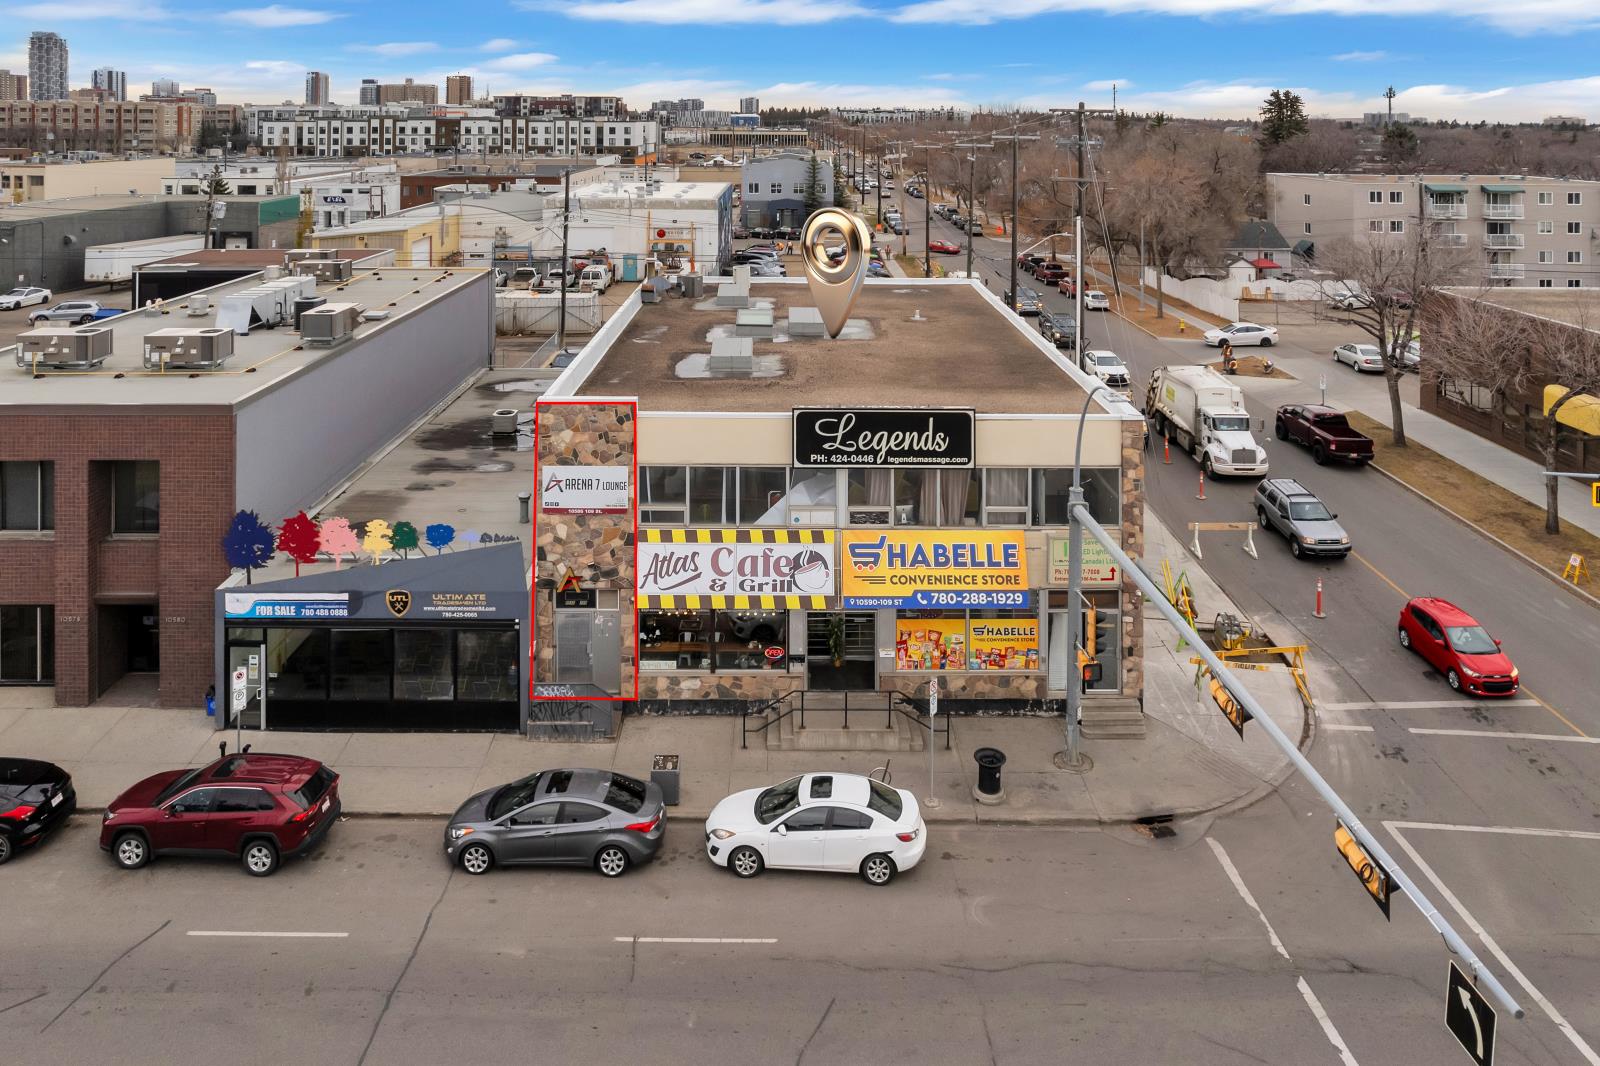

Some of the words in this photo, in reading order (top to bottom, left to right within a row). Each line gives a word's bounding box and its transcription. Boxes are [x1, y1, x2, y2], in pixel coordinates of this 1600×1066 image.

[814, 412, 949, 464] Legends
[810, 454, 828, 463] PH:
[830, 454, 874, 463] 424-0446
[887, 456, 968, 464] legendsmassage.com
[565, 478, 593, 491] ARENA
[595, 478, 600, 491] 7
[602, 481, 627, 491] LOUNGE
[848, 535, 1020, 572] SHABELLE
[639, 551, 702, 590] Atlas
[709, 578, 727, 592] &
[738, 578, 793, 593] Grill
[889, 575, 978, 586] CONVENIENCE
[981, 575, 1021, 586] STORE
[930, 592, 1023, 604] 780-288-1929
[255, 606, 272, 616] FOR
[274, 606, 296, 616] SALE
[973, 625, 1036, 636] SHABELLE
